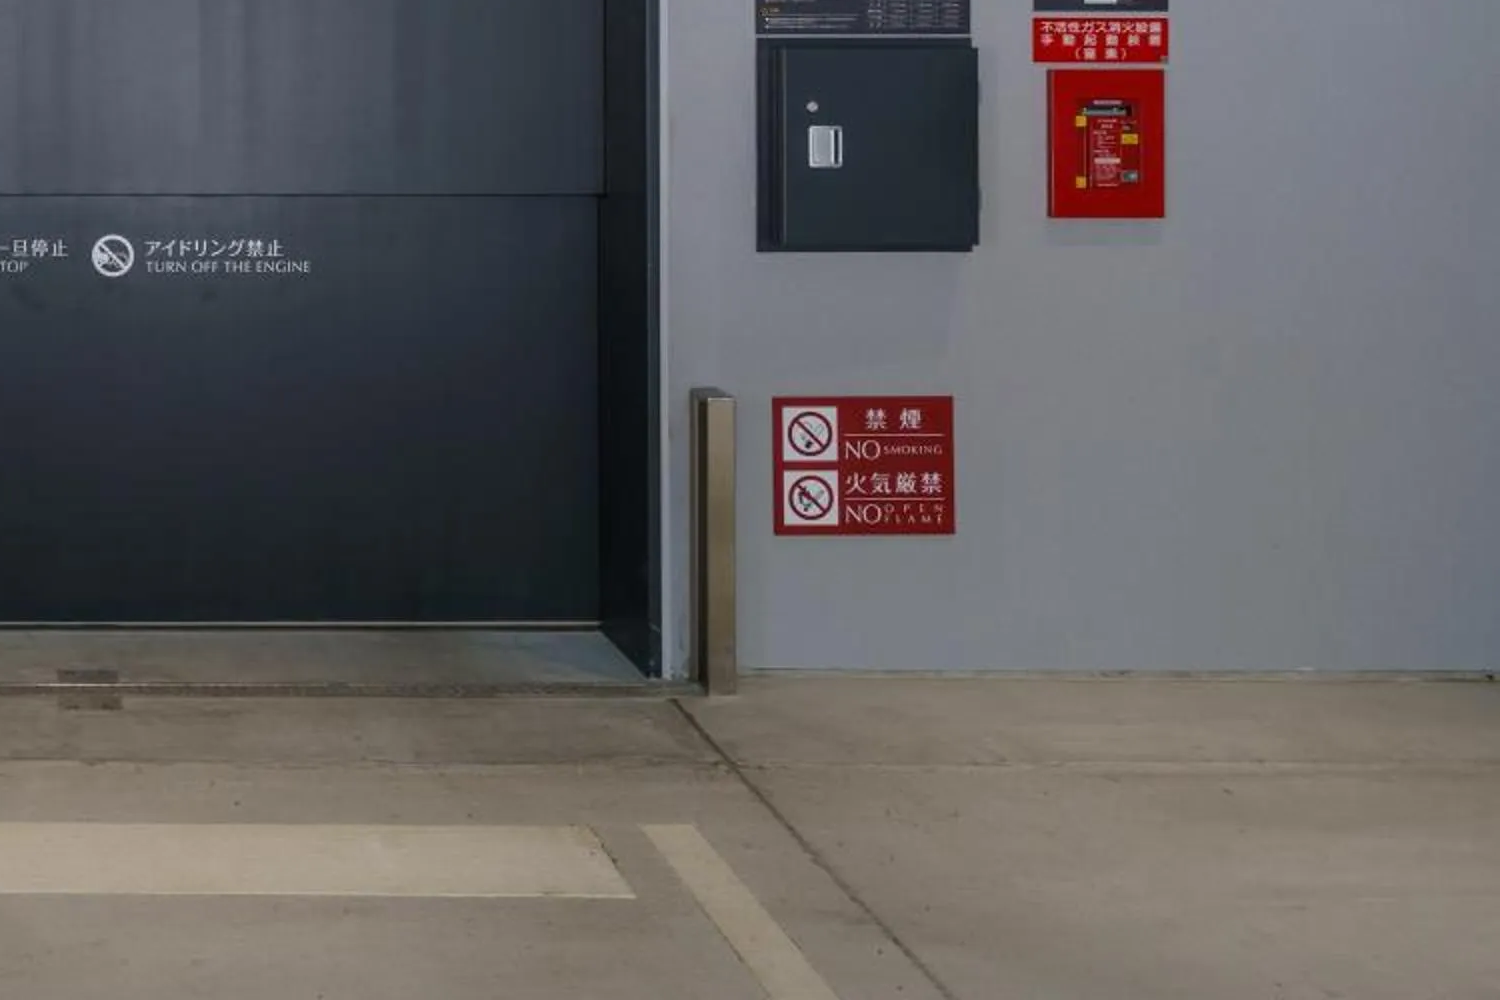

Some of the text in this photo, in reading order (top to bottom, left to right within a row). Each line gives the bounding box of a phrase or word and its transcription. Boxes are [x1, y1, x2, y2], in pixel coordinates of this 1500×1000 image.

[143, 239, 285, 257] アイドリング禁止
[145, 260, 312, 273] TURN OFF THE ENGINE
[865, 408, 922, 430] 禁煙
[845, 439, 943, 461] NO SMOKING
[845, 472, 943, 495] 火気厳禁
[844, 503, 882, 525] NO
[884, 503, 943, 514] OPEN
